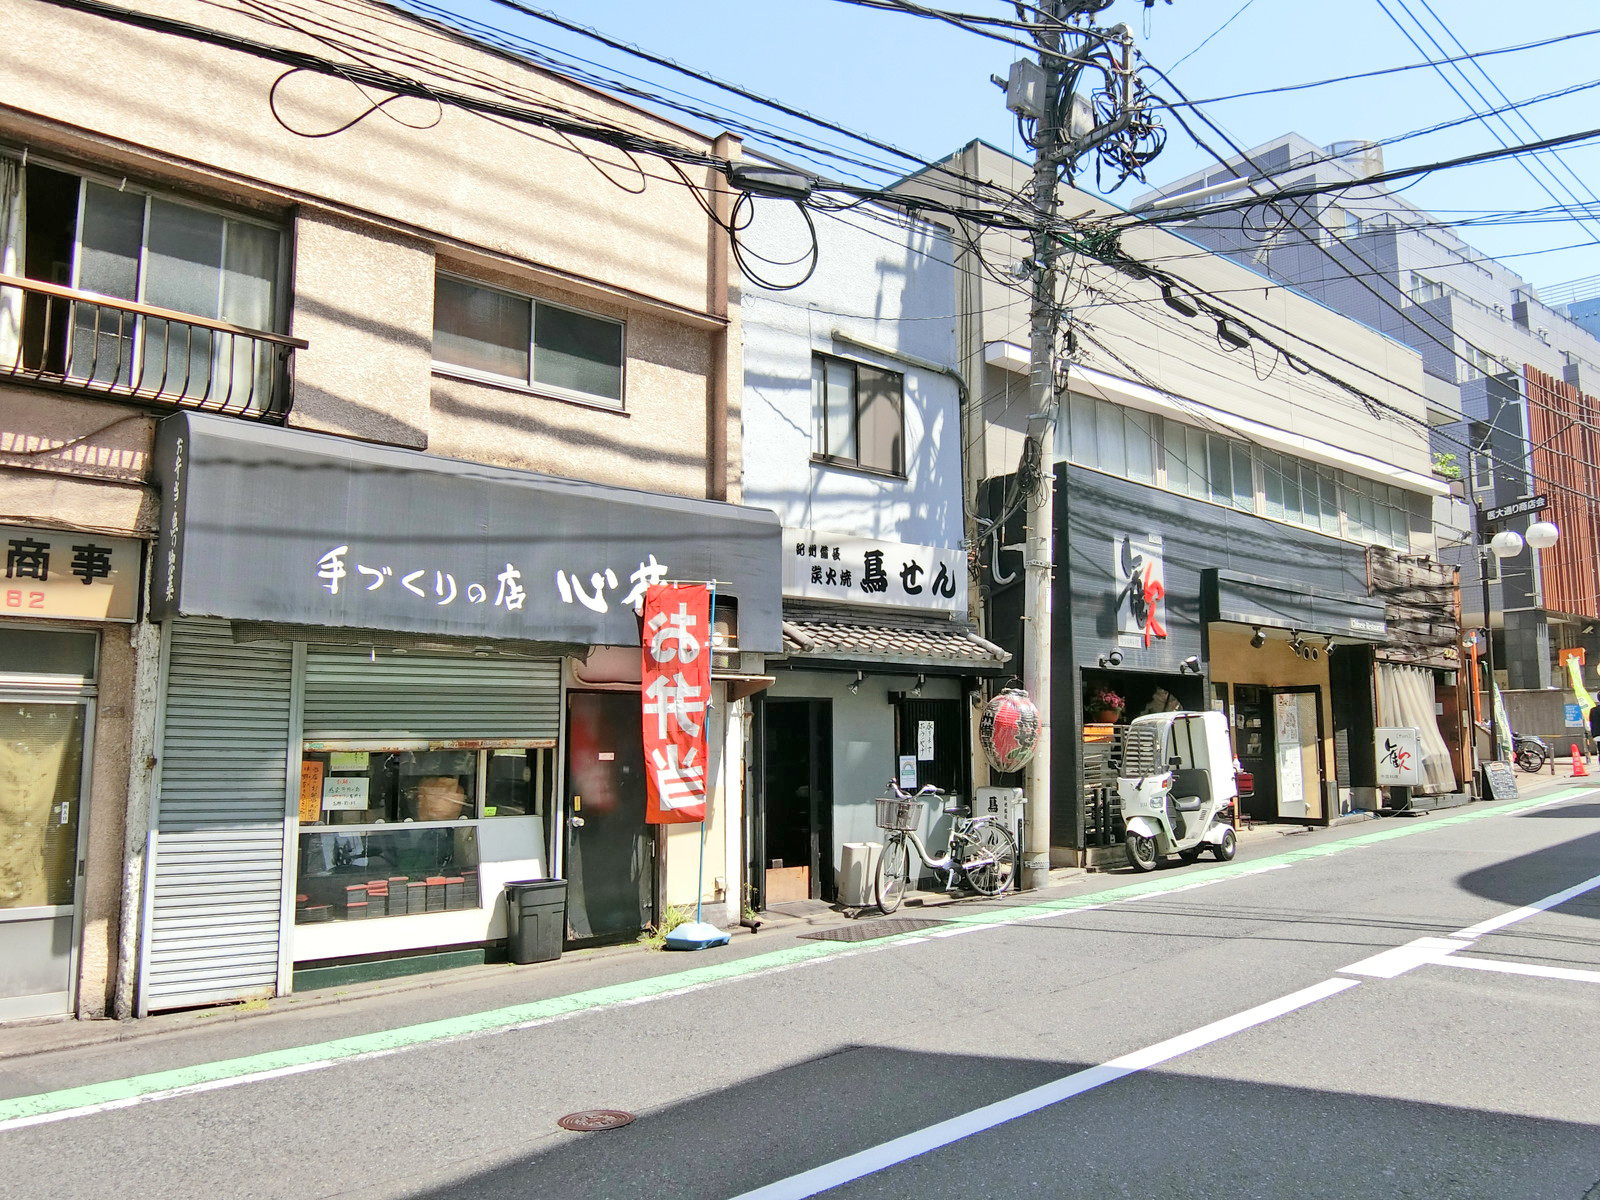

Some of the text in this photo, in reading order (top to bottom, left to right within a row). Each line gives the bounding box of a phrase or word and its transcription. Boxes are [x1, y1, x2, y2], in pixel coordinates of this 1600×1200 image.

[1486, 497, 1545, 521] 医大通り商店会
[5, 537, 113, 585] 商事
[796, 542, 841, 561] 紀州備長
[316, 544, 526, 611] 手づくりの店
[811, 565, 852, 587] 炭火焼
[859, 549, 956, 598] 馬せん
[6, 589, 45, 609] 82
